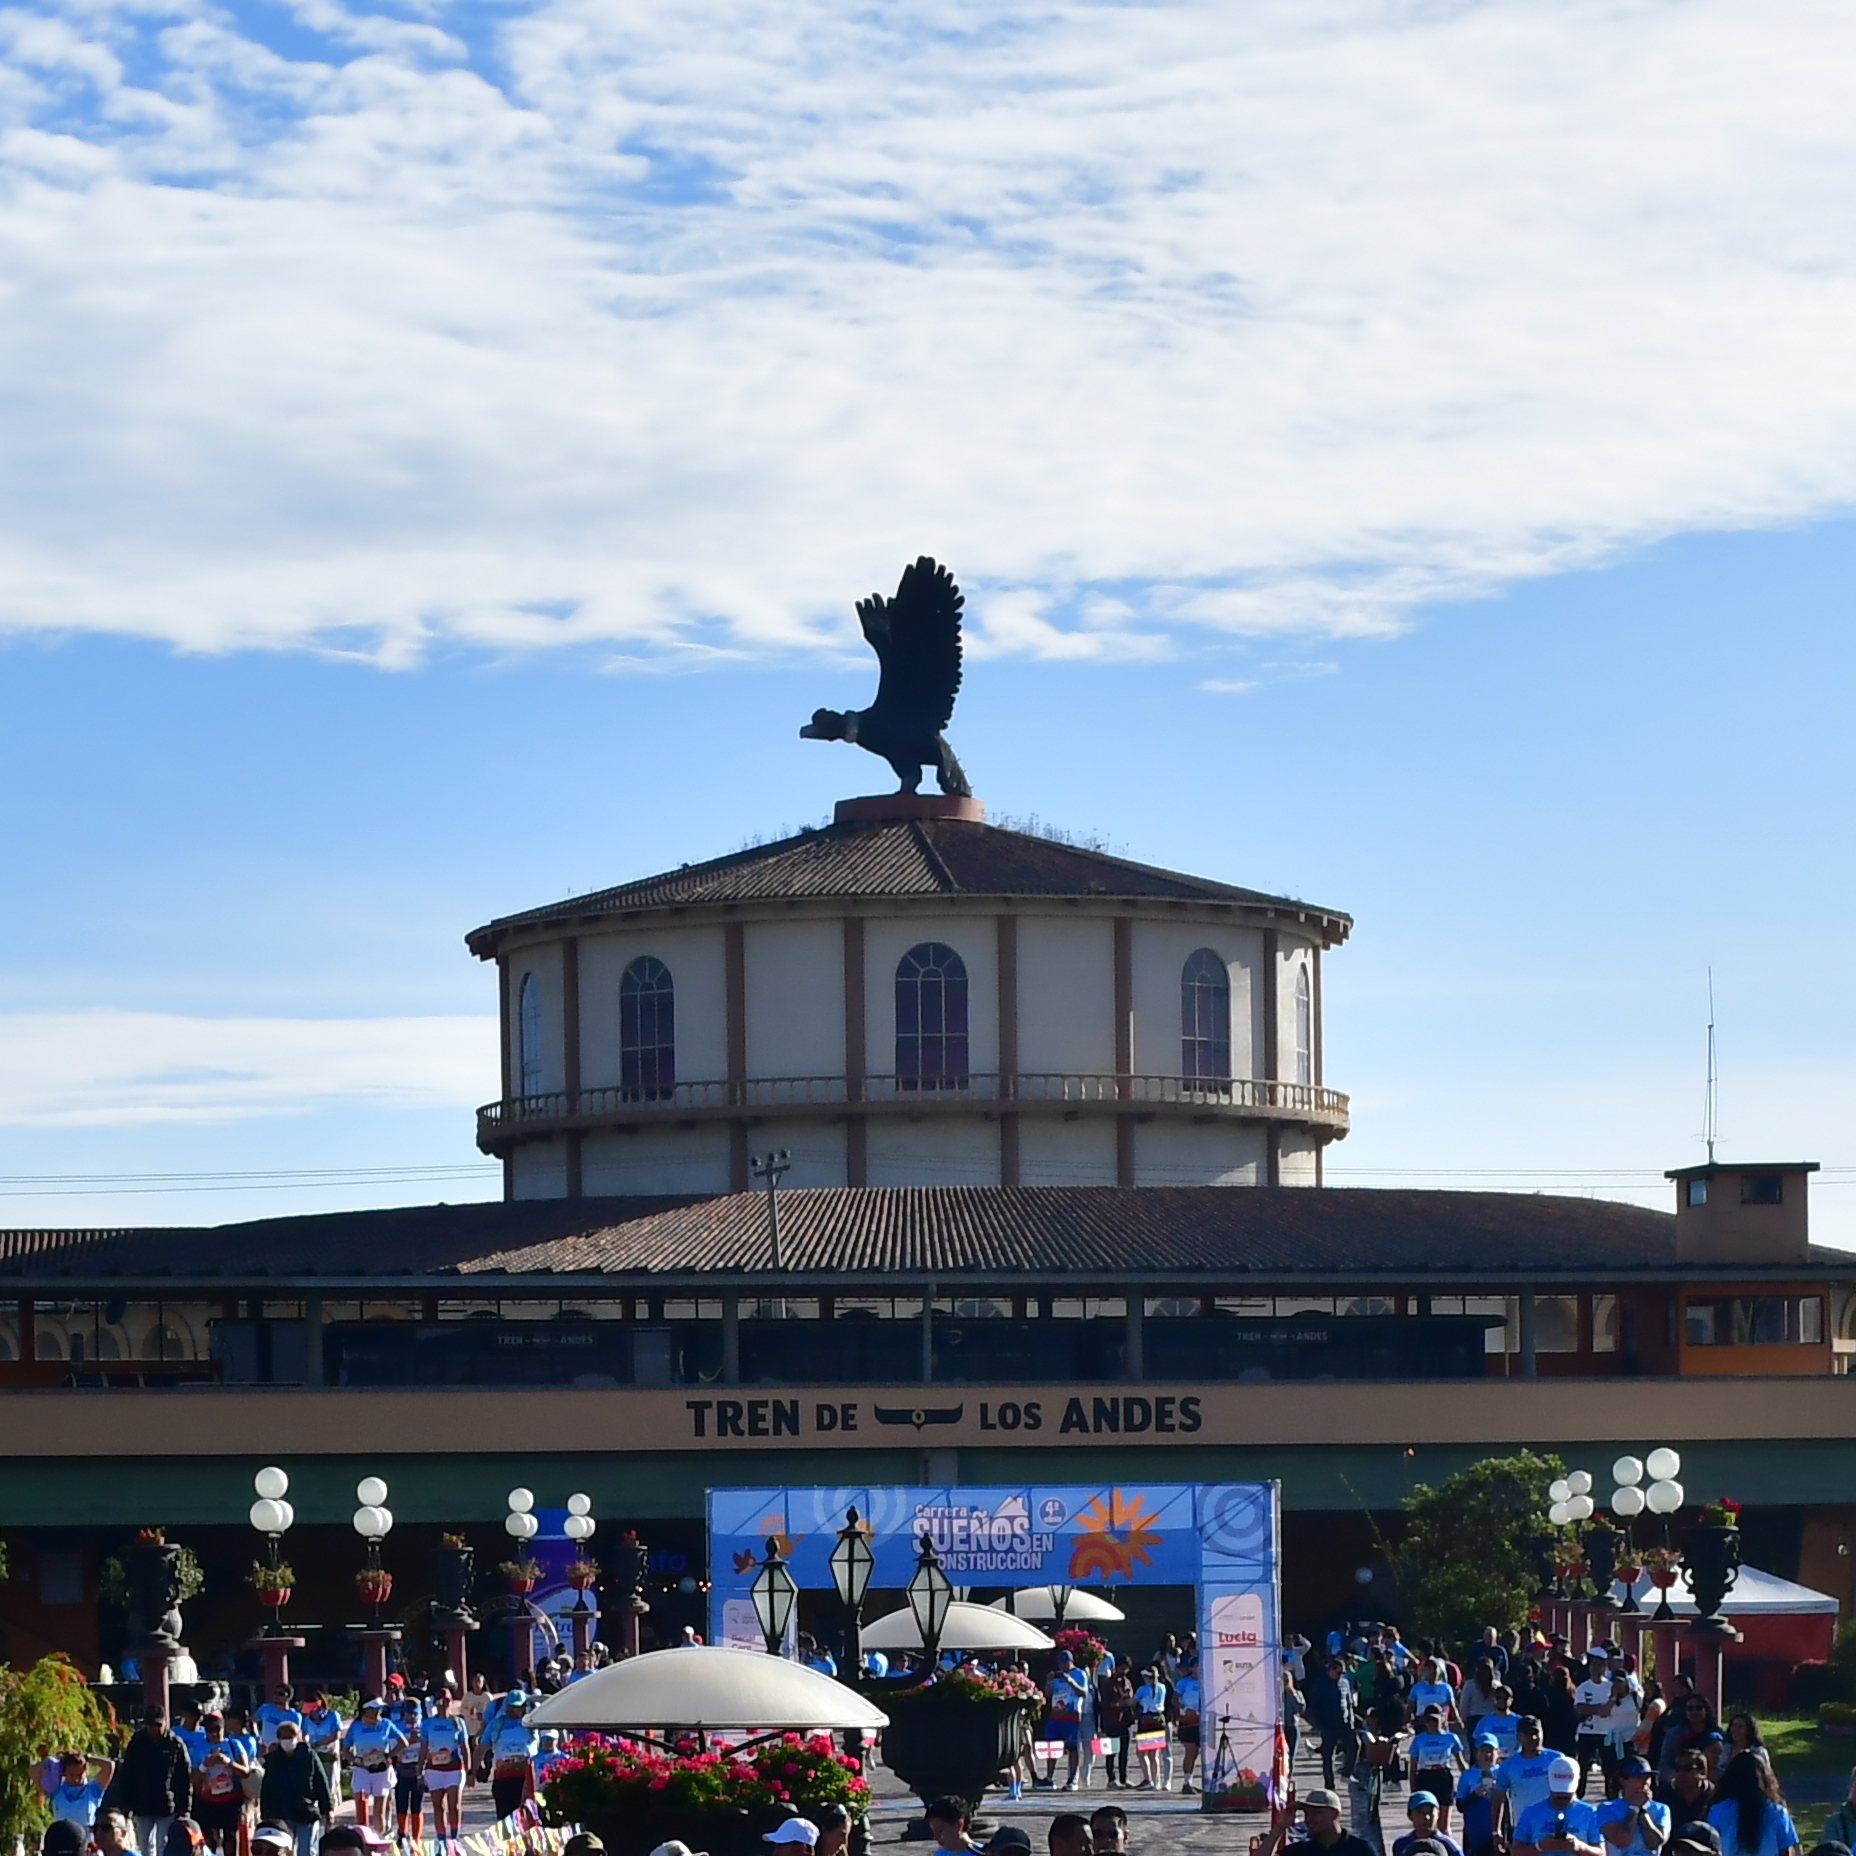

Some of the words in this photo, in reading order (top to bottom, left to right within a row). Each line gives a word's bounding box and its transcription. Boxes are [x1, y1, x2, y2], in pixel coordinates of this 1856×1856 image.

[686, 1400, 800, 1437] TREN
[816, 1403, 857, 1431] DE
[980, 1402, 1042, 1431] LOS
[1059, 1397, 1203, 1434] ANDES
[915, 1505, 968, 1518] Carrera
[912, 1511, 1031, 1553] SUEÑOS
[1032, 1534, 1053, 1551] EN
[938, 1551, 1042, 1571] ONSTRUCCIÓN
